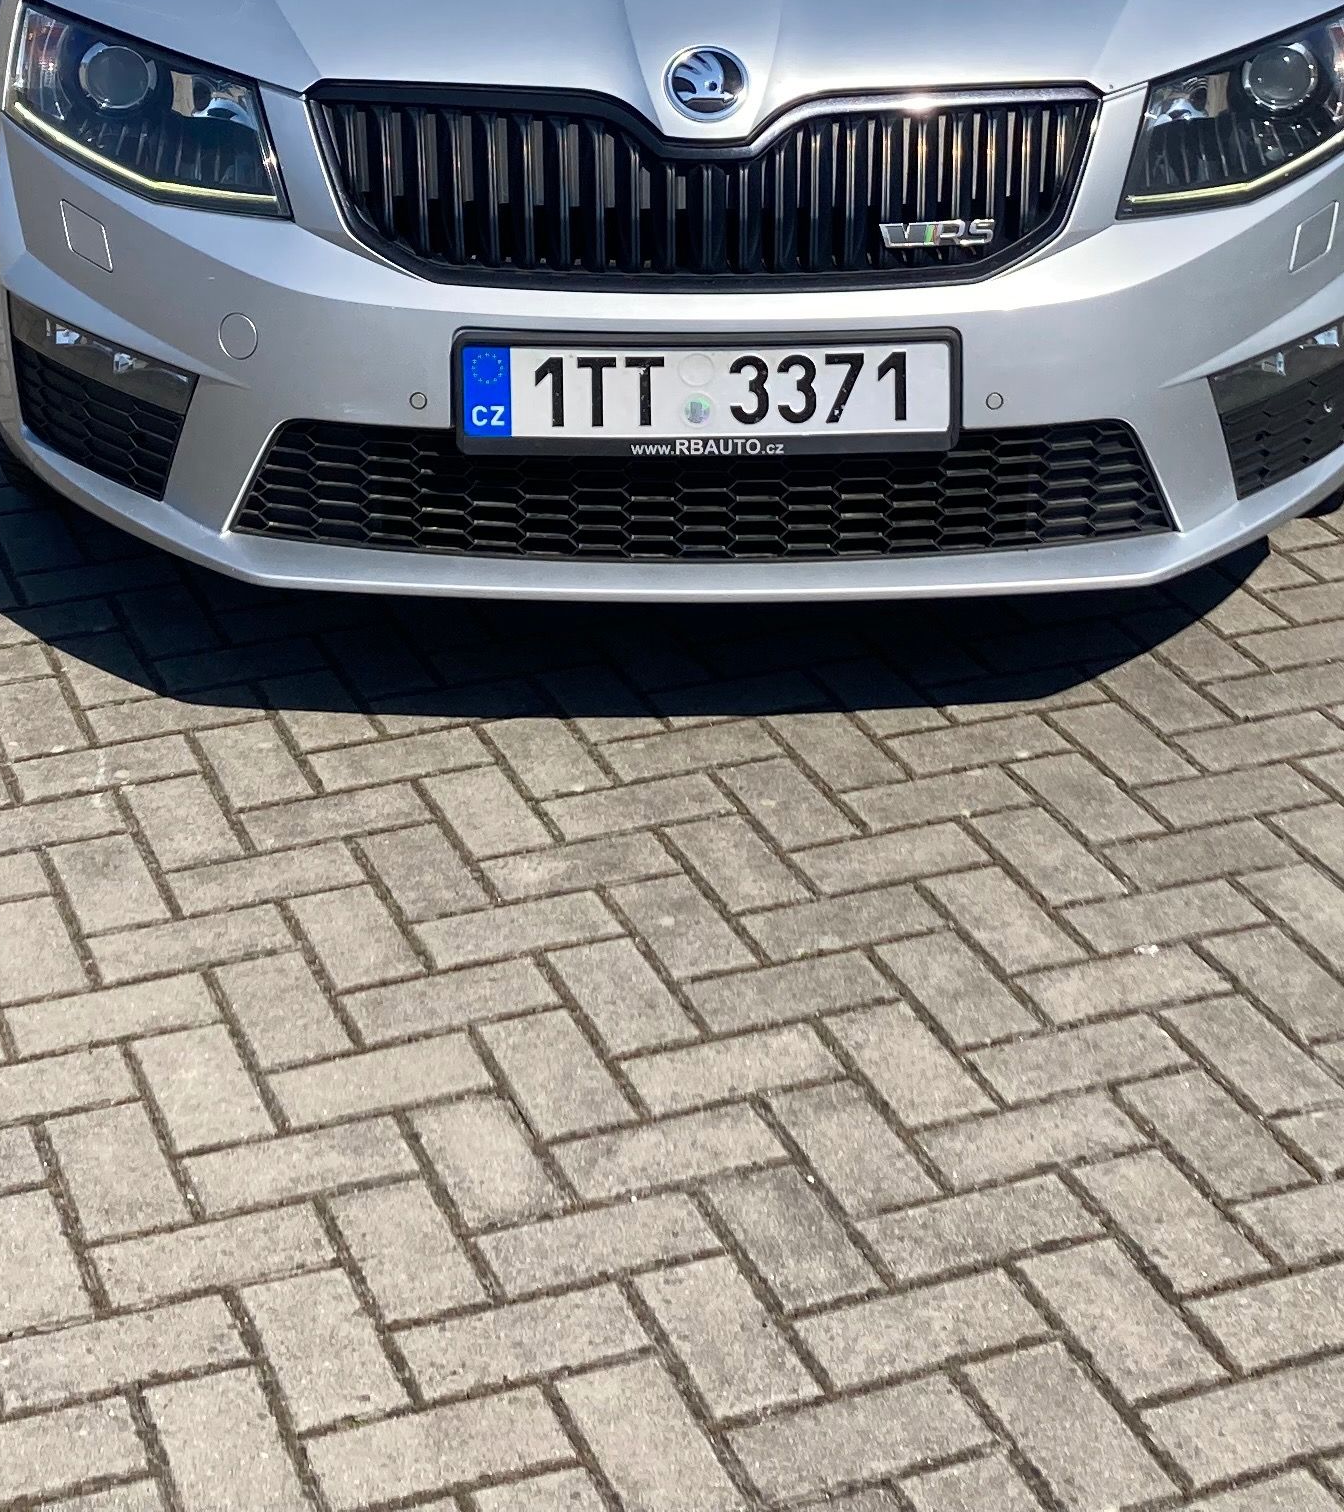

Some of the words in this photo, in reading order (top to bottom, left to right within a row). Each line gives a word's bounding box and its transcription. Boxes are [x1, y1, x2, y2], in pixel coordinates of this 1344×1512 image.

[534, 356, 666, 428] 1TT
[728, 351, 908, 425] 3371
[470, 404, 506, 427] CZ
[630, 438, 785, 456] www.RBAUTO.cz
